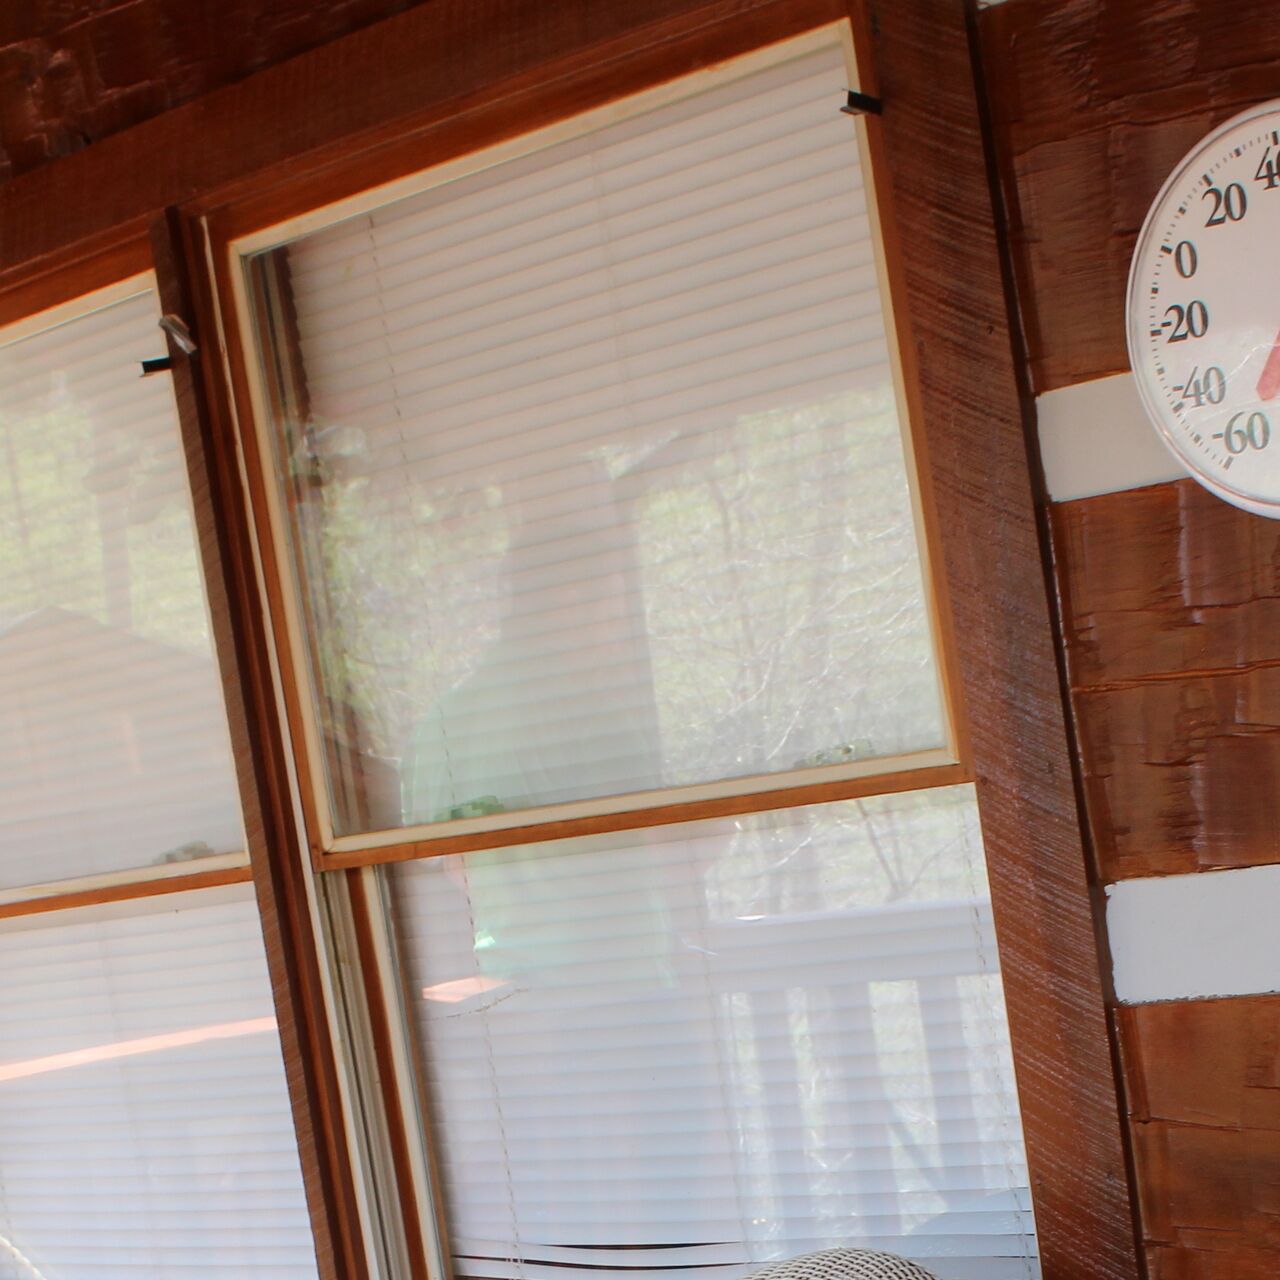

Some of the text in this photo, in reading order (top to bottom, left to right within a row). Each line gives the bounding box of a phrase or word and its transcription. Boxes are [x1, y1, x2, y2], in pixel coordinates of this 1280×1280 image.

[1201, 182, 1247, 227] 20
[1174, 240, 1197, 278] 0
[1161, 300, 1209, 343] -20
[1172, 365, 1227, 409] -40
[1212, 411, 1270, 455] -60
